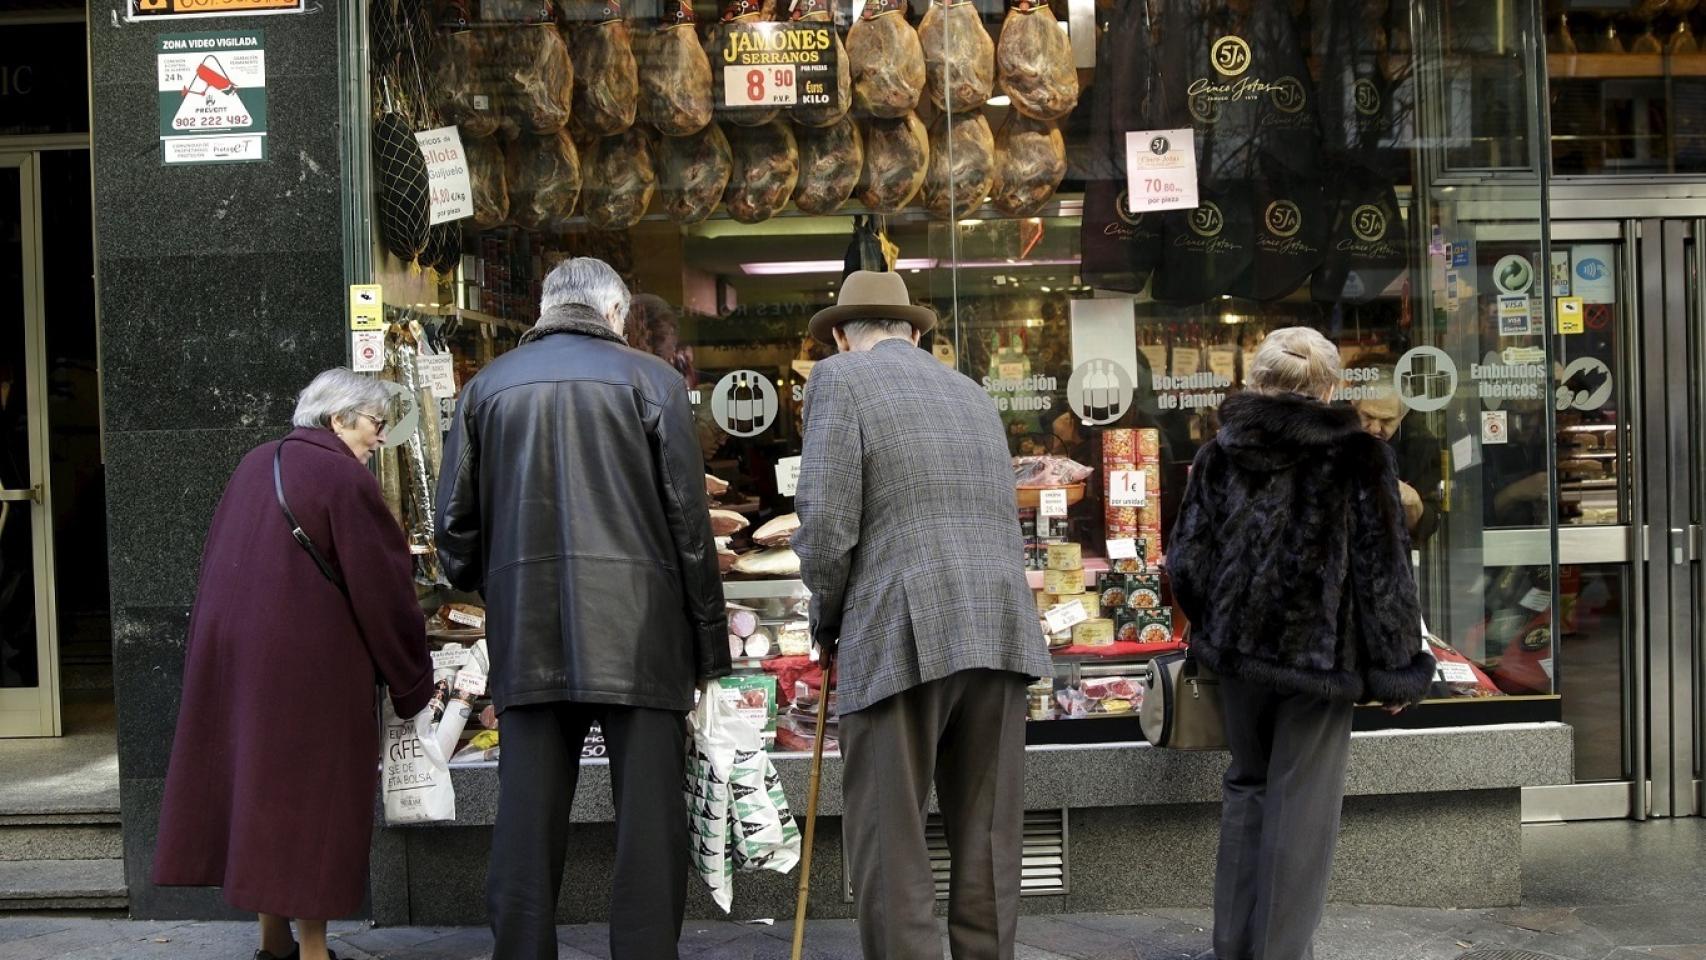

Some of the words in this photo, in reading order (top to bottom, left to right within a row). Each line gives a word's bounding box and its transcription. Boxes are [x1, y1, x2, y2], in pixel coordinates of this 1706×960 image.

[163, 40, 187, 50] ZONA
[189, 38, 216, 48] VIDEO
[216, 37, 258, 48] VIGILADA
[724, 29, 830, 62] JAMONES
[743, 50, 819, 64] SERRANOS
[164, 74, 175, 82] 24
[774, 94, 791, 102] P.V.P.
[802, 94, 830, 104] KILO
[176, 117, 196, 127] 902
[200, 116, 222, 126] 222
[226, 114, 248, 124] 492
[1144, 178, 1162, 193] 70
[1504, 301, 1522, 309] VISA
[1152, 372, 1231, 390] Bocadillos
[1479, 380, 1538, 398] ibéricos
[1010, 395, 1052, 411] vinos
[1158, 392, 1178, 410] de
[1122, 472, 1128, 492] 1
[1132, 482, 1137, 492] €
[402, 762, 414, 773] DE
[404, 772, 432, 785] BOLSA
